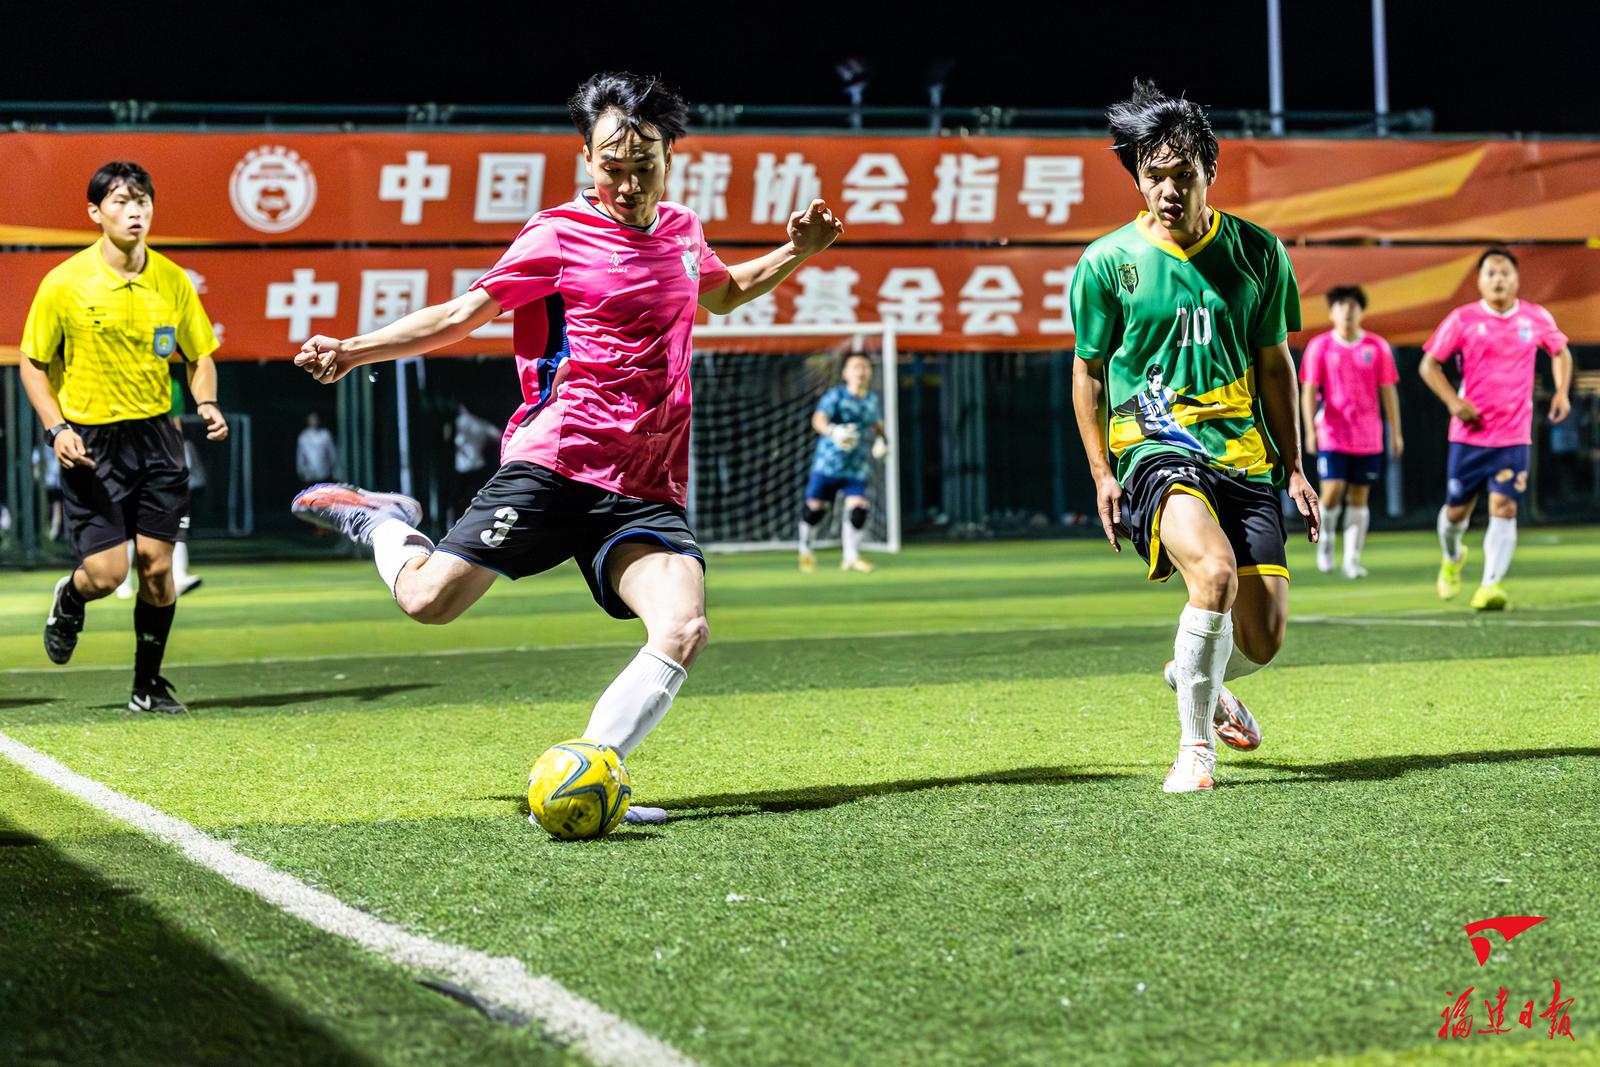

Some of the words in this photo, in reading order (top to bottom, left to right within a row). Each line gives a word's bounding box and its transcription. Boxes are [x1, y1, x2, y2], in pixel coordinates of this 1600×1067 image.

[379, 150, 1084, 226] 中国球协会指导
[1176, 306, 1212, 347] 10
[480, 506, 519, 547] 3
